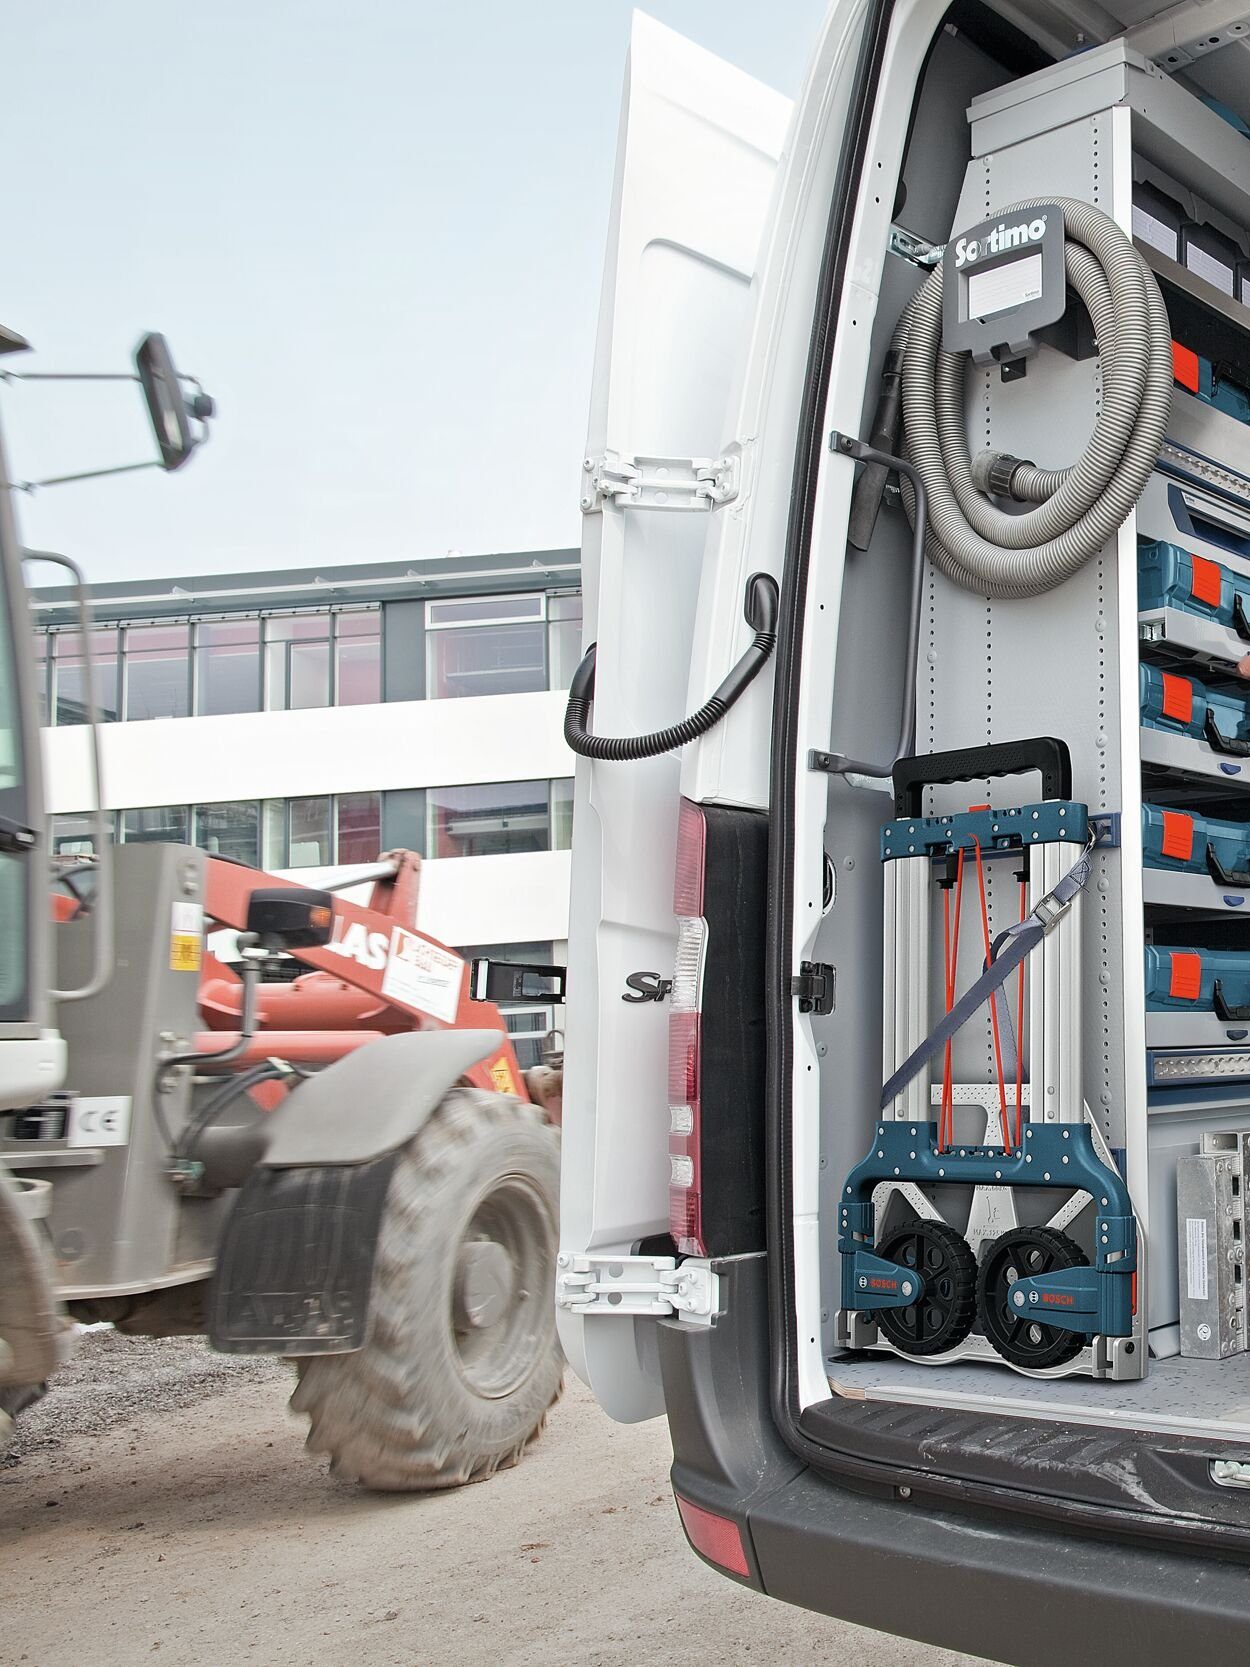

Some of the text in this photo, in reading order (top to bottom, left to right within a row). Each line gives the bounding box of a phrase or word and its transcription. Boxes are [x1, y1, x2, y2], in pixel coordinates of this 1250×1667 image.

[322, 914, 390, 970] LAS
[869, 1278, 897, 1289] BOSCH
[1042, 1293, 1074, 1305] BOSCH
